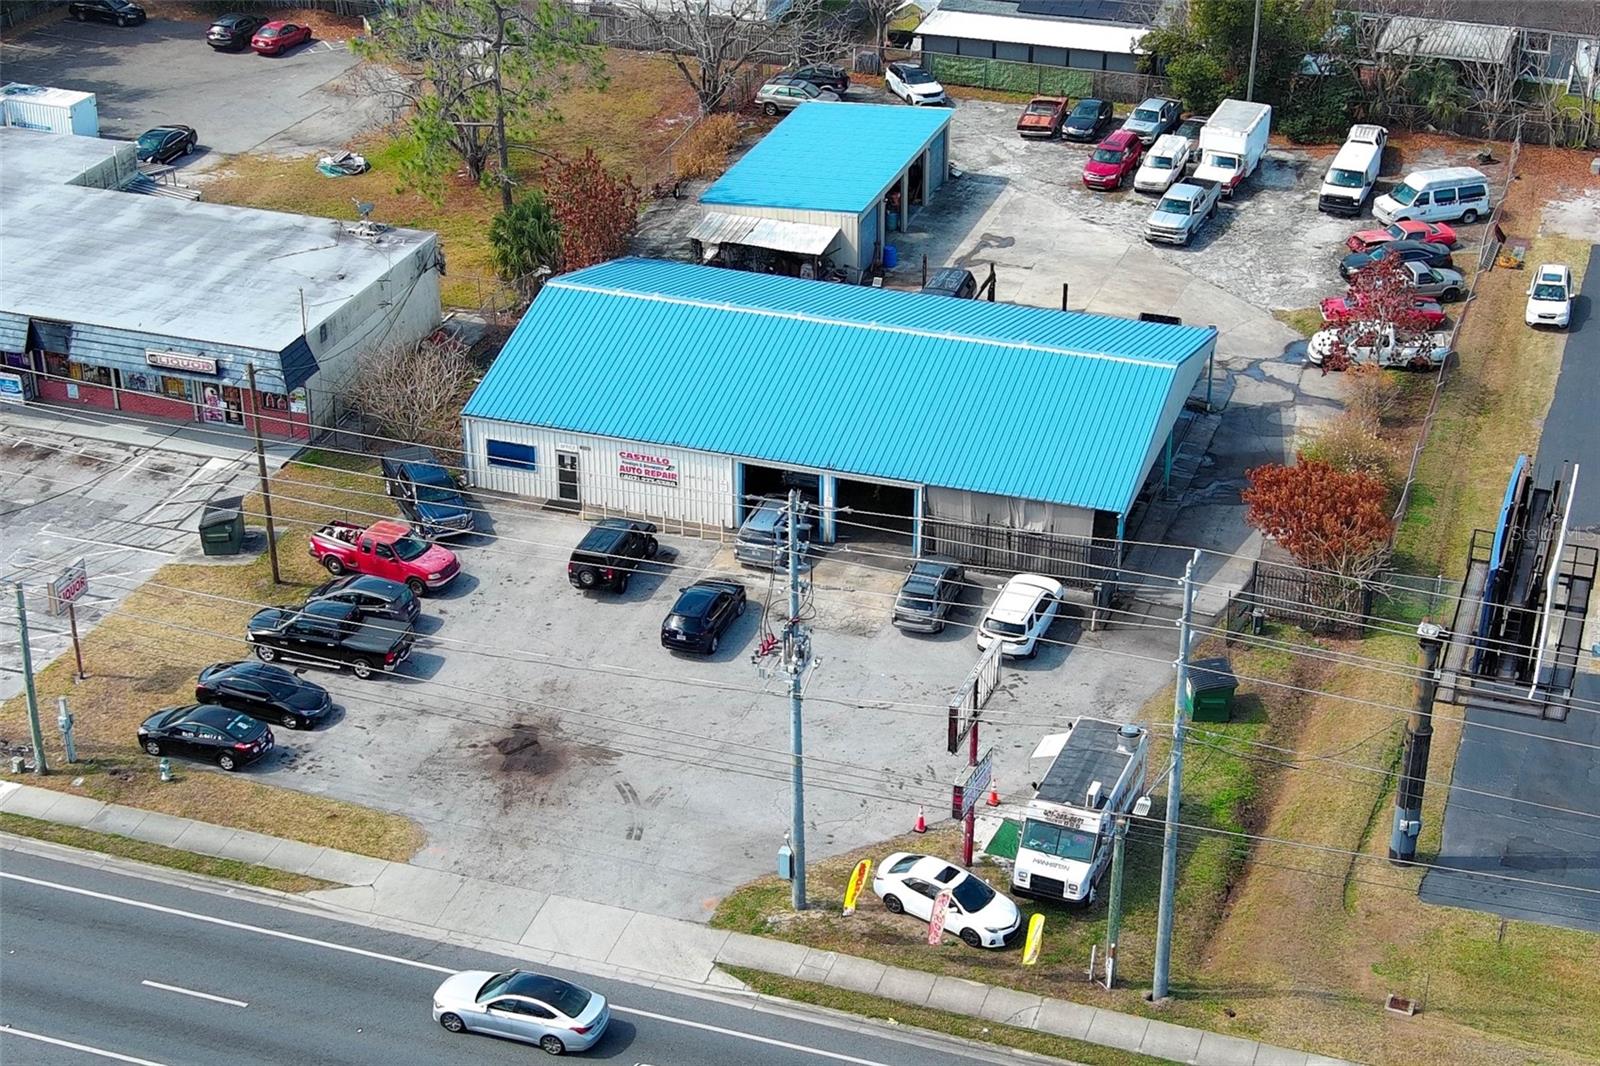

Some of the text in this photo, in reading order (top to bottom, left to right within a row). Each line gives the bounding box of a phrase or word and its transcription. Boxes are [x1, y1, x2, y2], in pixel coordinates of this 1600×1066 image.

[158, 356, 210, 371] LIQUOR
[619, 451, 670, 465] CASTILLO
[619, 465, 643, 475] AUTO
[644, 469, 678, 480] REPAIR
